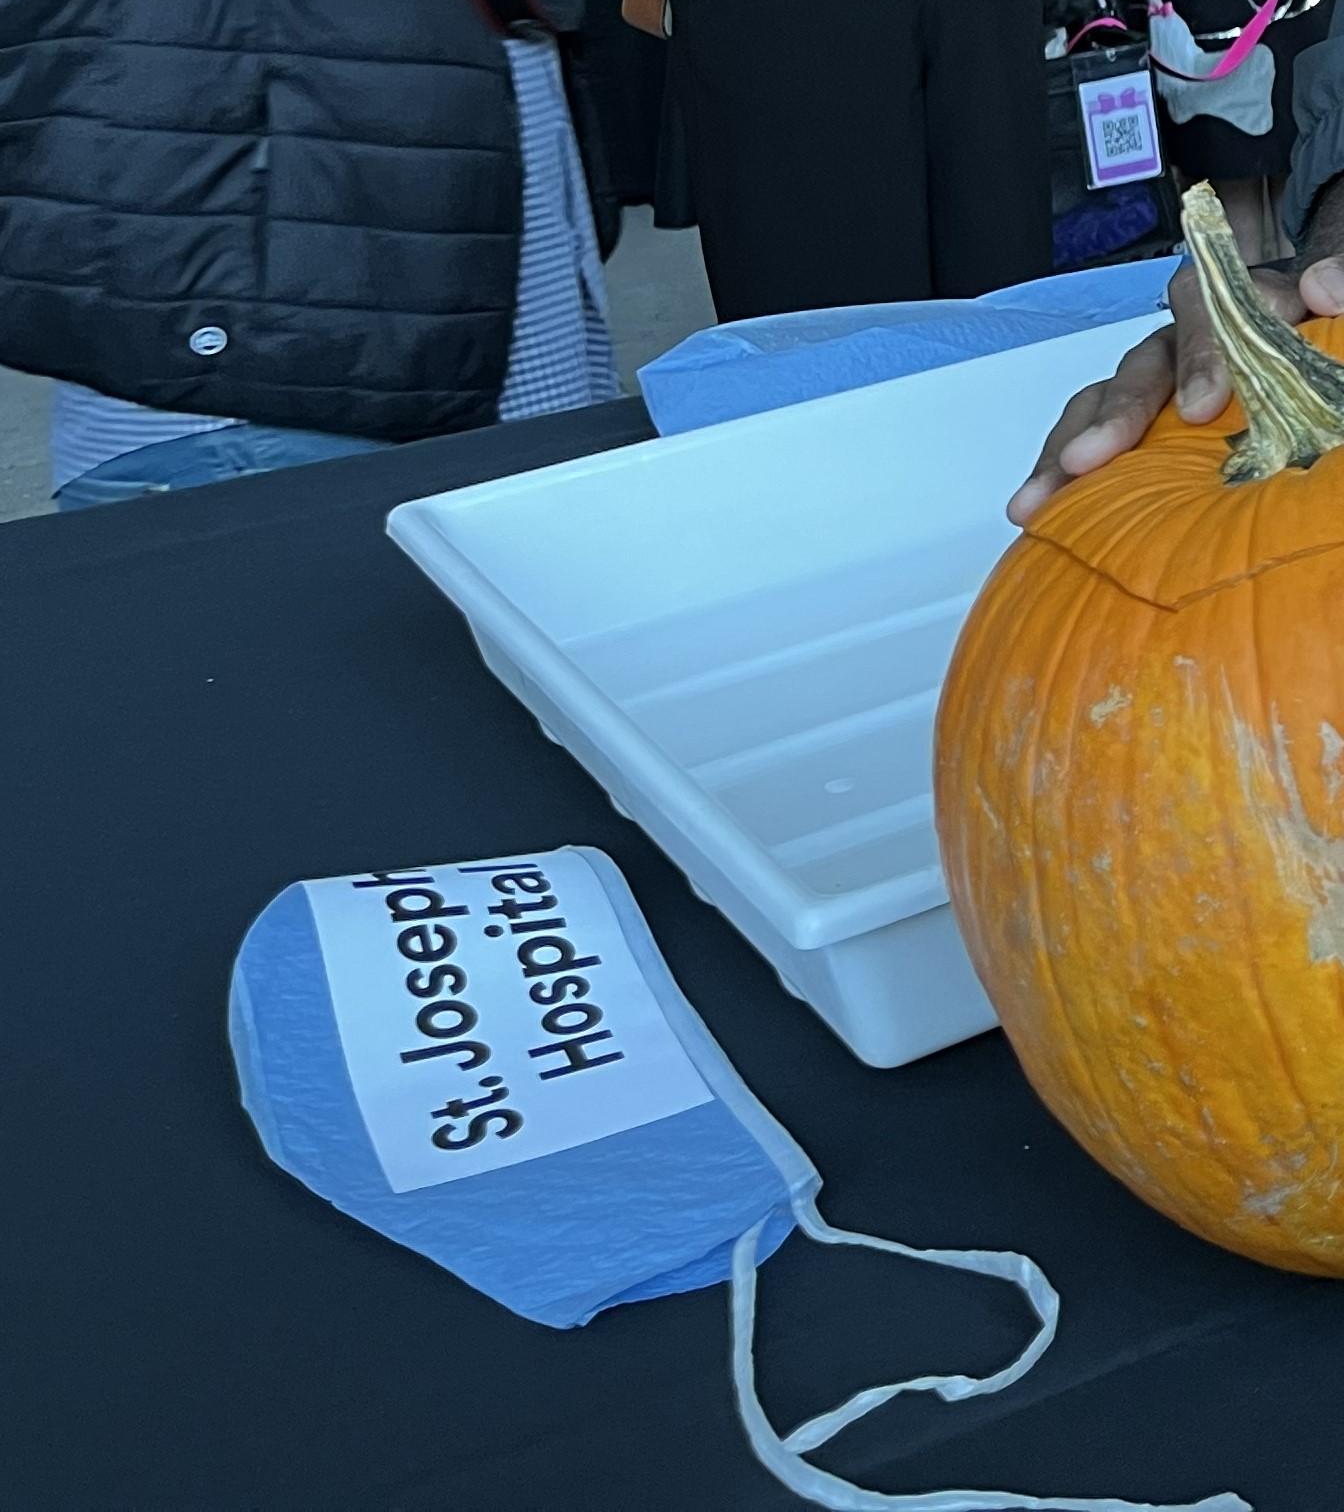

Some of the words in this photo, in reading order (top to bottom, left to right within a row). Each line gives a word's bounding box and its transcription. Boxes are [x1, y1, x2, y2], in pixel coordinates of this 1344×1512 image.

[352, 866, 491, 1072] Joseph
[456, 863, 626, 1082] Hospital
[430, 1074, 524, 1153] St.
